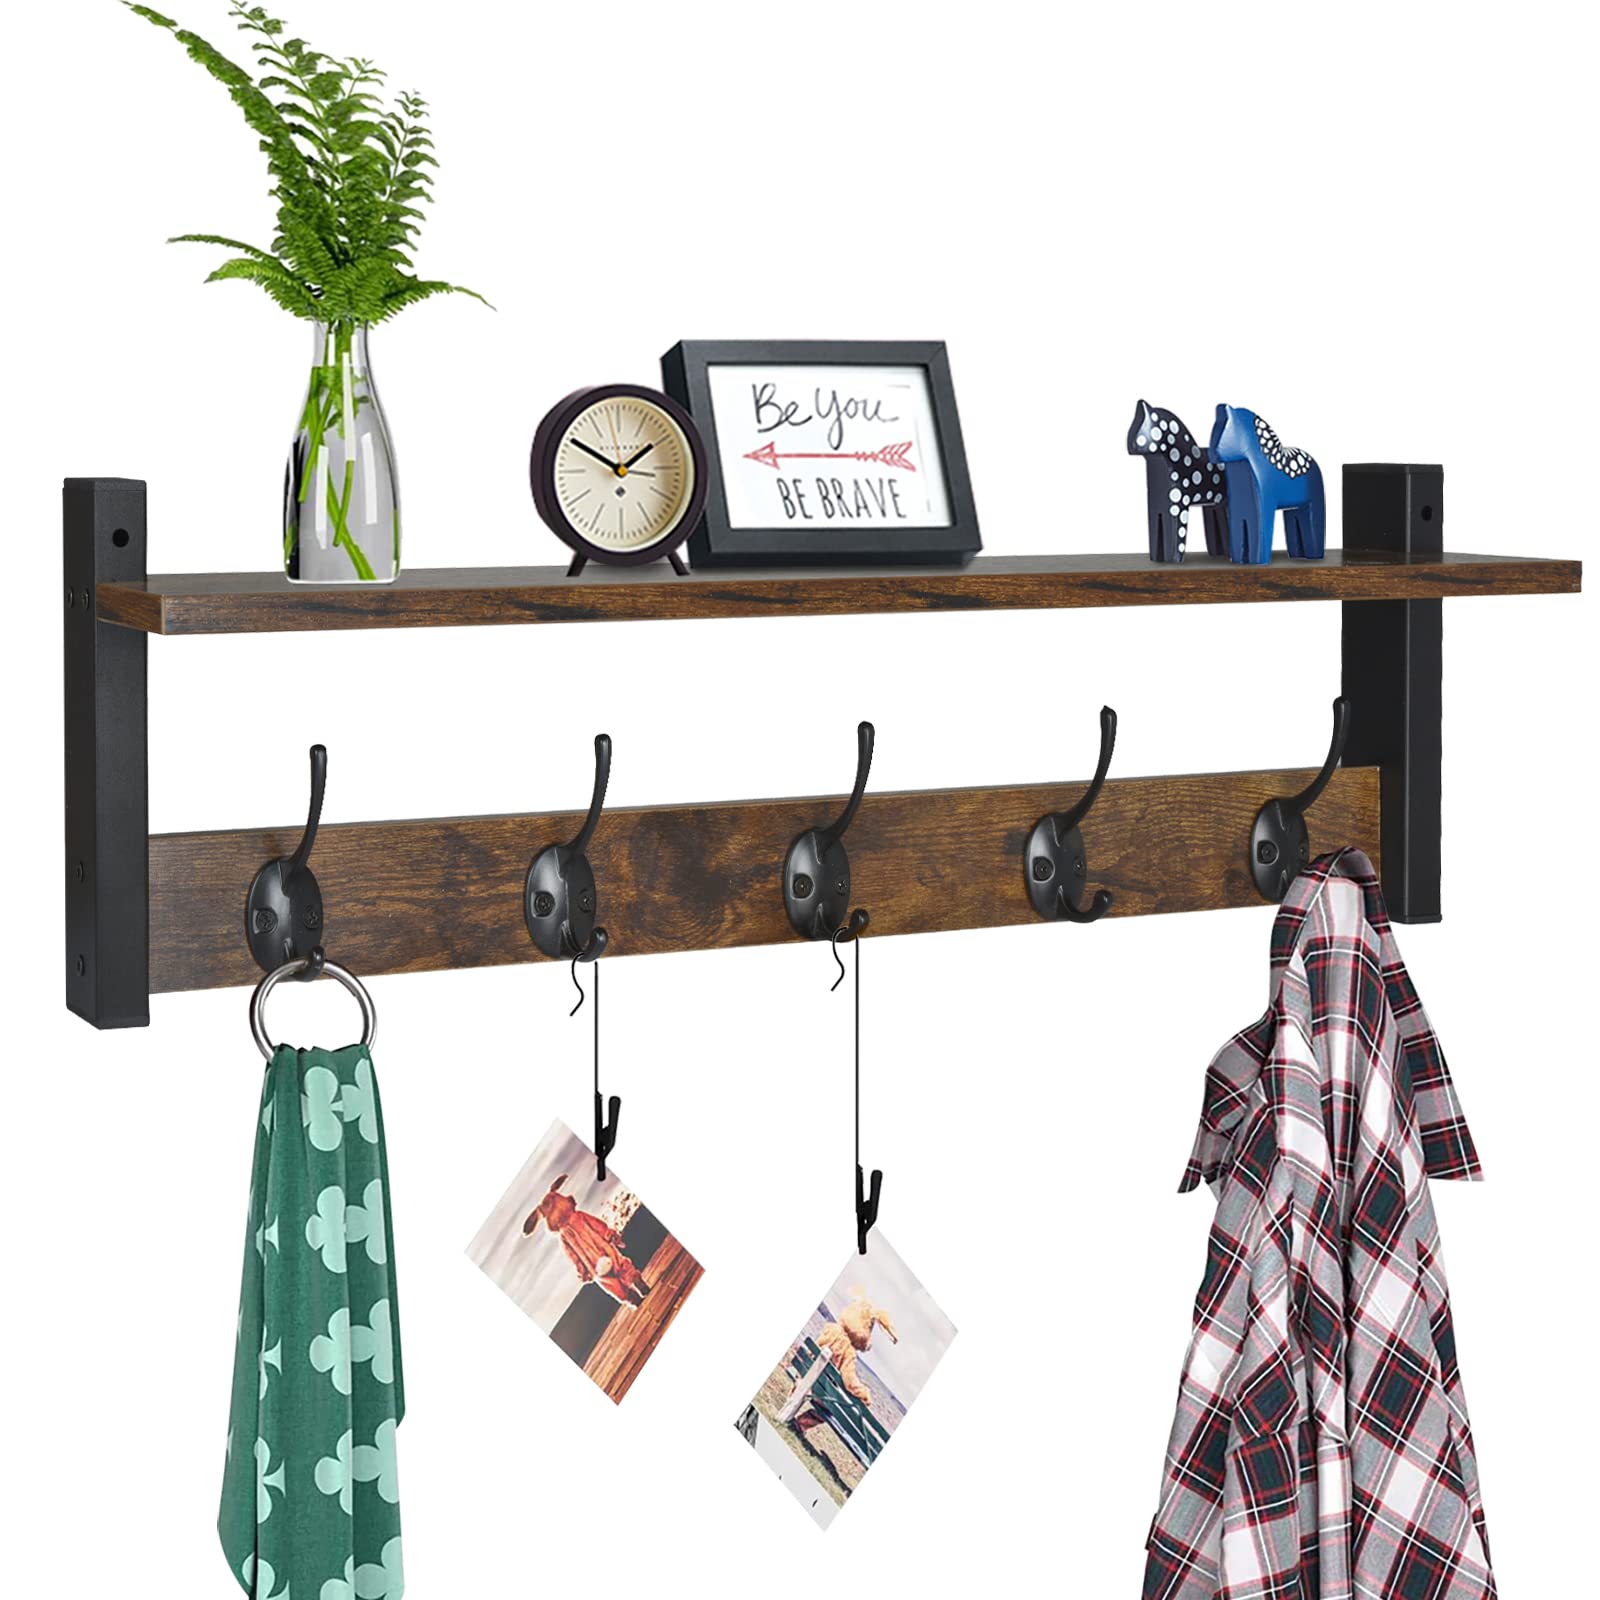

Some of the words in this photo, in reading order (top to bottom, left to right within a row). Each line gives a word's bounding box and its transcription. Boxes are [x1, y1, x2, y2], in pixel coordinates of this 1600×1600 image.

[752, 383, 813, 433] Be
[815, 387, 900, 450] You
[776, 478, 813, 520] BE
[816, 478, 907, 520] BRAVE
